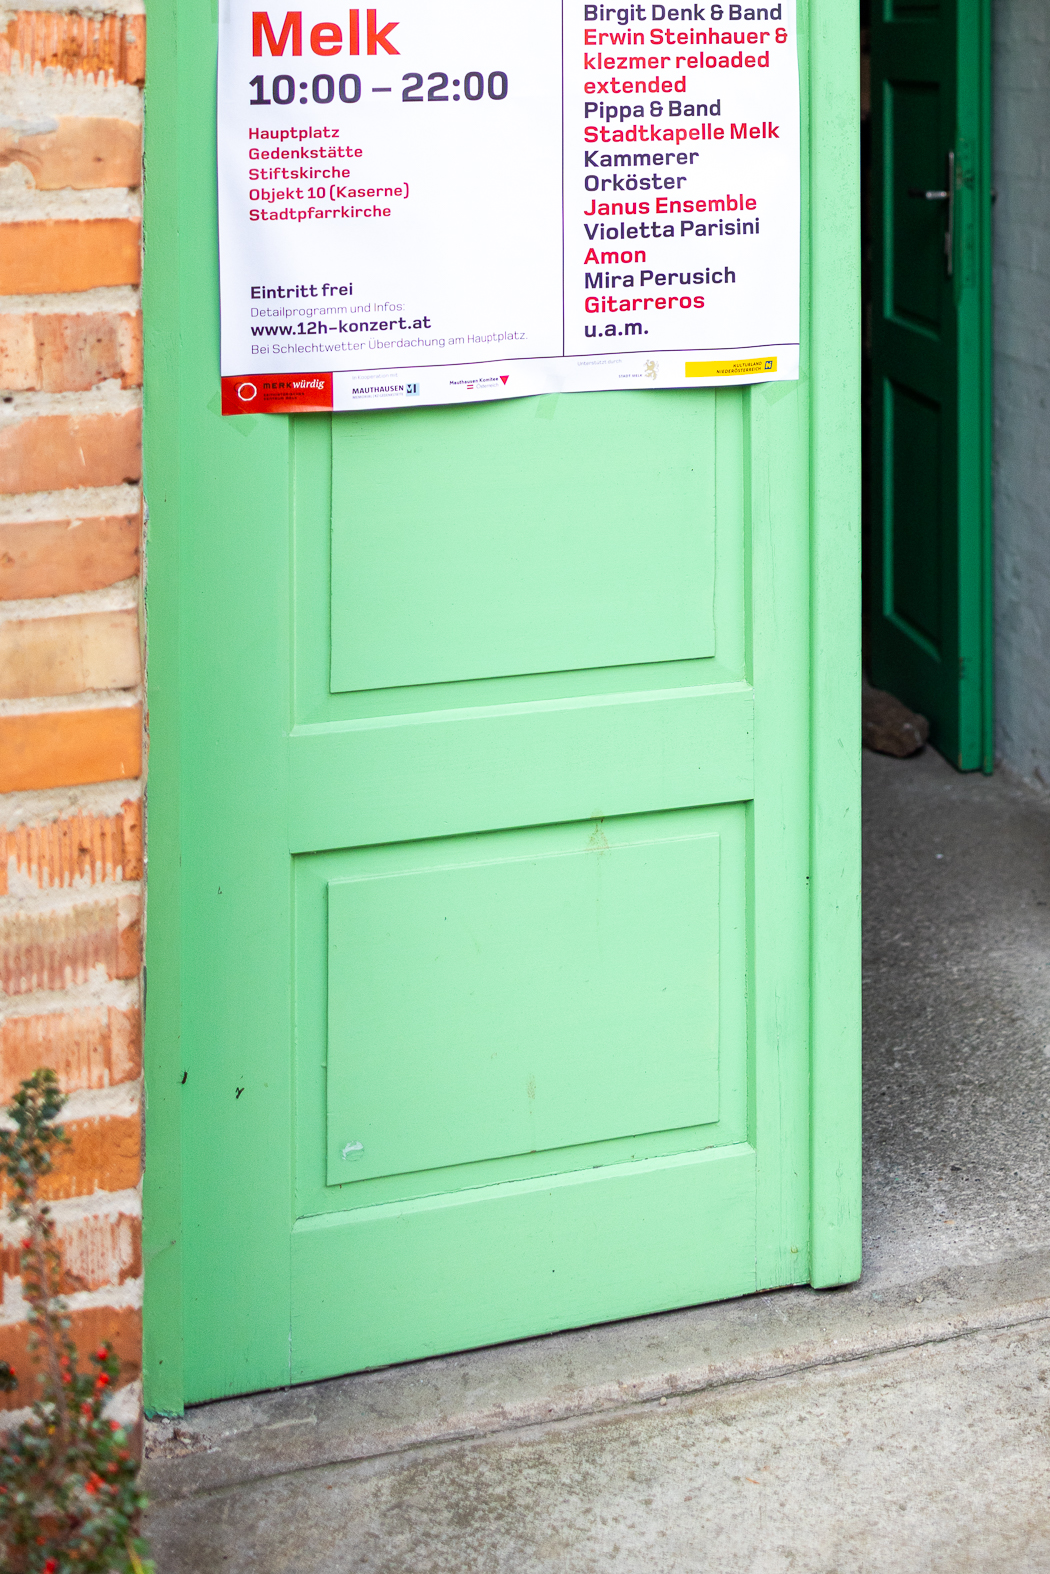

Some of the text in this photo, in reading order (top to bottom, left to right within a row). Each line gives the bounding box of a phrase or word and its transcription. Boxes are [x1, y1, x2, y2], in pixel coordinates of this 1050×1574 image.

[584, 3, 782, 25] Birgit Denk & Band
[252, 9, 400, 57] Melk
[584, 27, 788, 45] Erwin Steinhauer &
[584, 50, 769, 70] klezmer reloaded
[249, 73, 361, 105] 10:00
[402, 71, 508, 102] 22:00
[584, 75, 686, 94] extended
[585, 99, 721, 123] Pippa & Band
[249, 126, 339, 142] Hauptplatz
[584, 121, 779, 145] Stadtkapelle Melk
[249, 146, 363, 160] Gedenkstätte
[585, 150, 699, 167] Kammerer
[249, 166, 350, 180] Stiftskirche
[584, 173, 687, 191] Orköster
[249, 182, 409, 203] Objekt 10 (Kaserne)
[249, 205, 391, 223] Stadtpfarrkirche
[584, 194, 757, 216] Janus Ensemble
[584, 217, 759, 240] Violetta Parisini
[584, 248, 646, 265] Amon
[585, 266, 736, 289] Mira Perusich
[251, 282, 352, 299] Eintritt frei
[250, 301, 406, 318] Detailprogramm und Infos:
[585, 296, 705, 313] Gitarreros
[251, 315, 432, 337] www.12h-konzert.at
[585, 322, 648, 338] u.a.m.
[251, 330, 529, 354] Bei Schlechtwetter Überdachung am Hauptplatz.
[352, 384, 404, 395] MAUTHAUSEN
